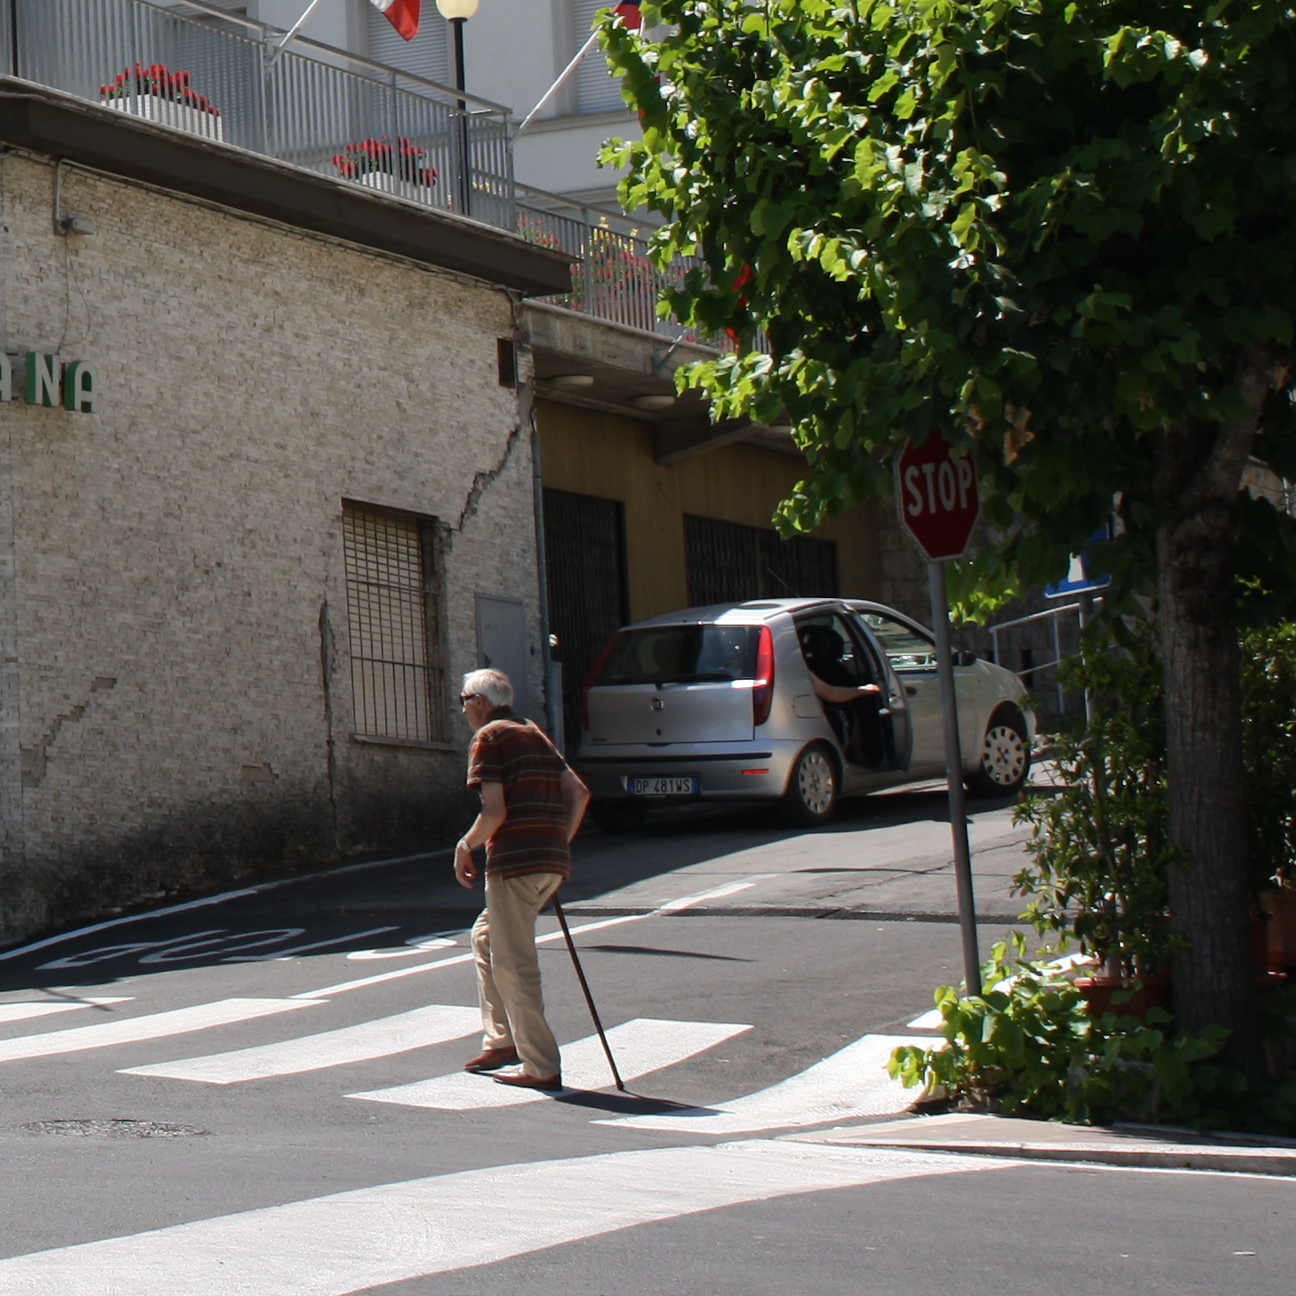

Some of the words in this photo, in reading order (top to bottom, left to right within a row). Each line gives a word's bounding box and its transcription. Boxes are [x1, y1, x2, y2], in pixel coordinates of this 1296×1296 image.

[904, 458, 973, 517] STOP
[636, 779, 649, 793] DP
[654, 779, 691, 793] 481WS
